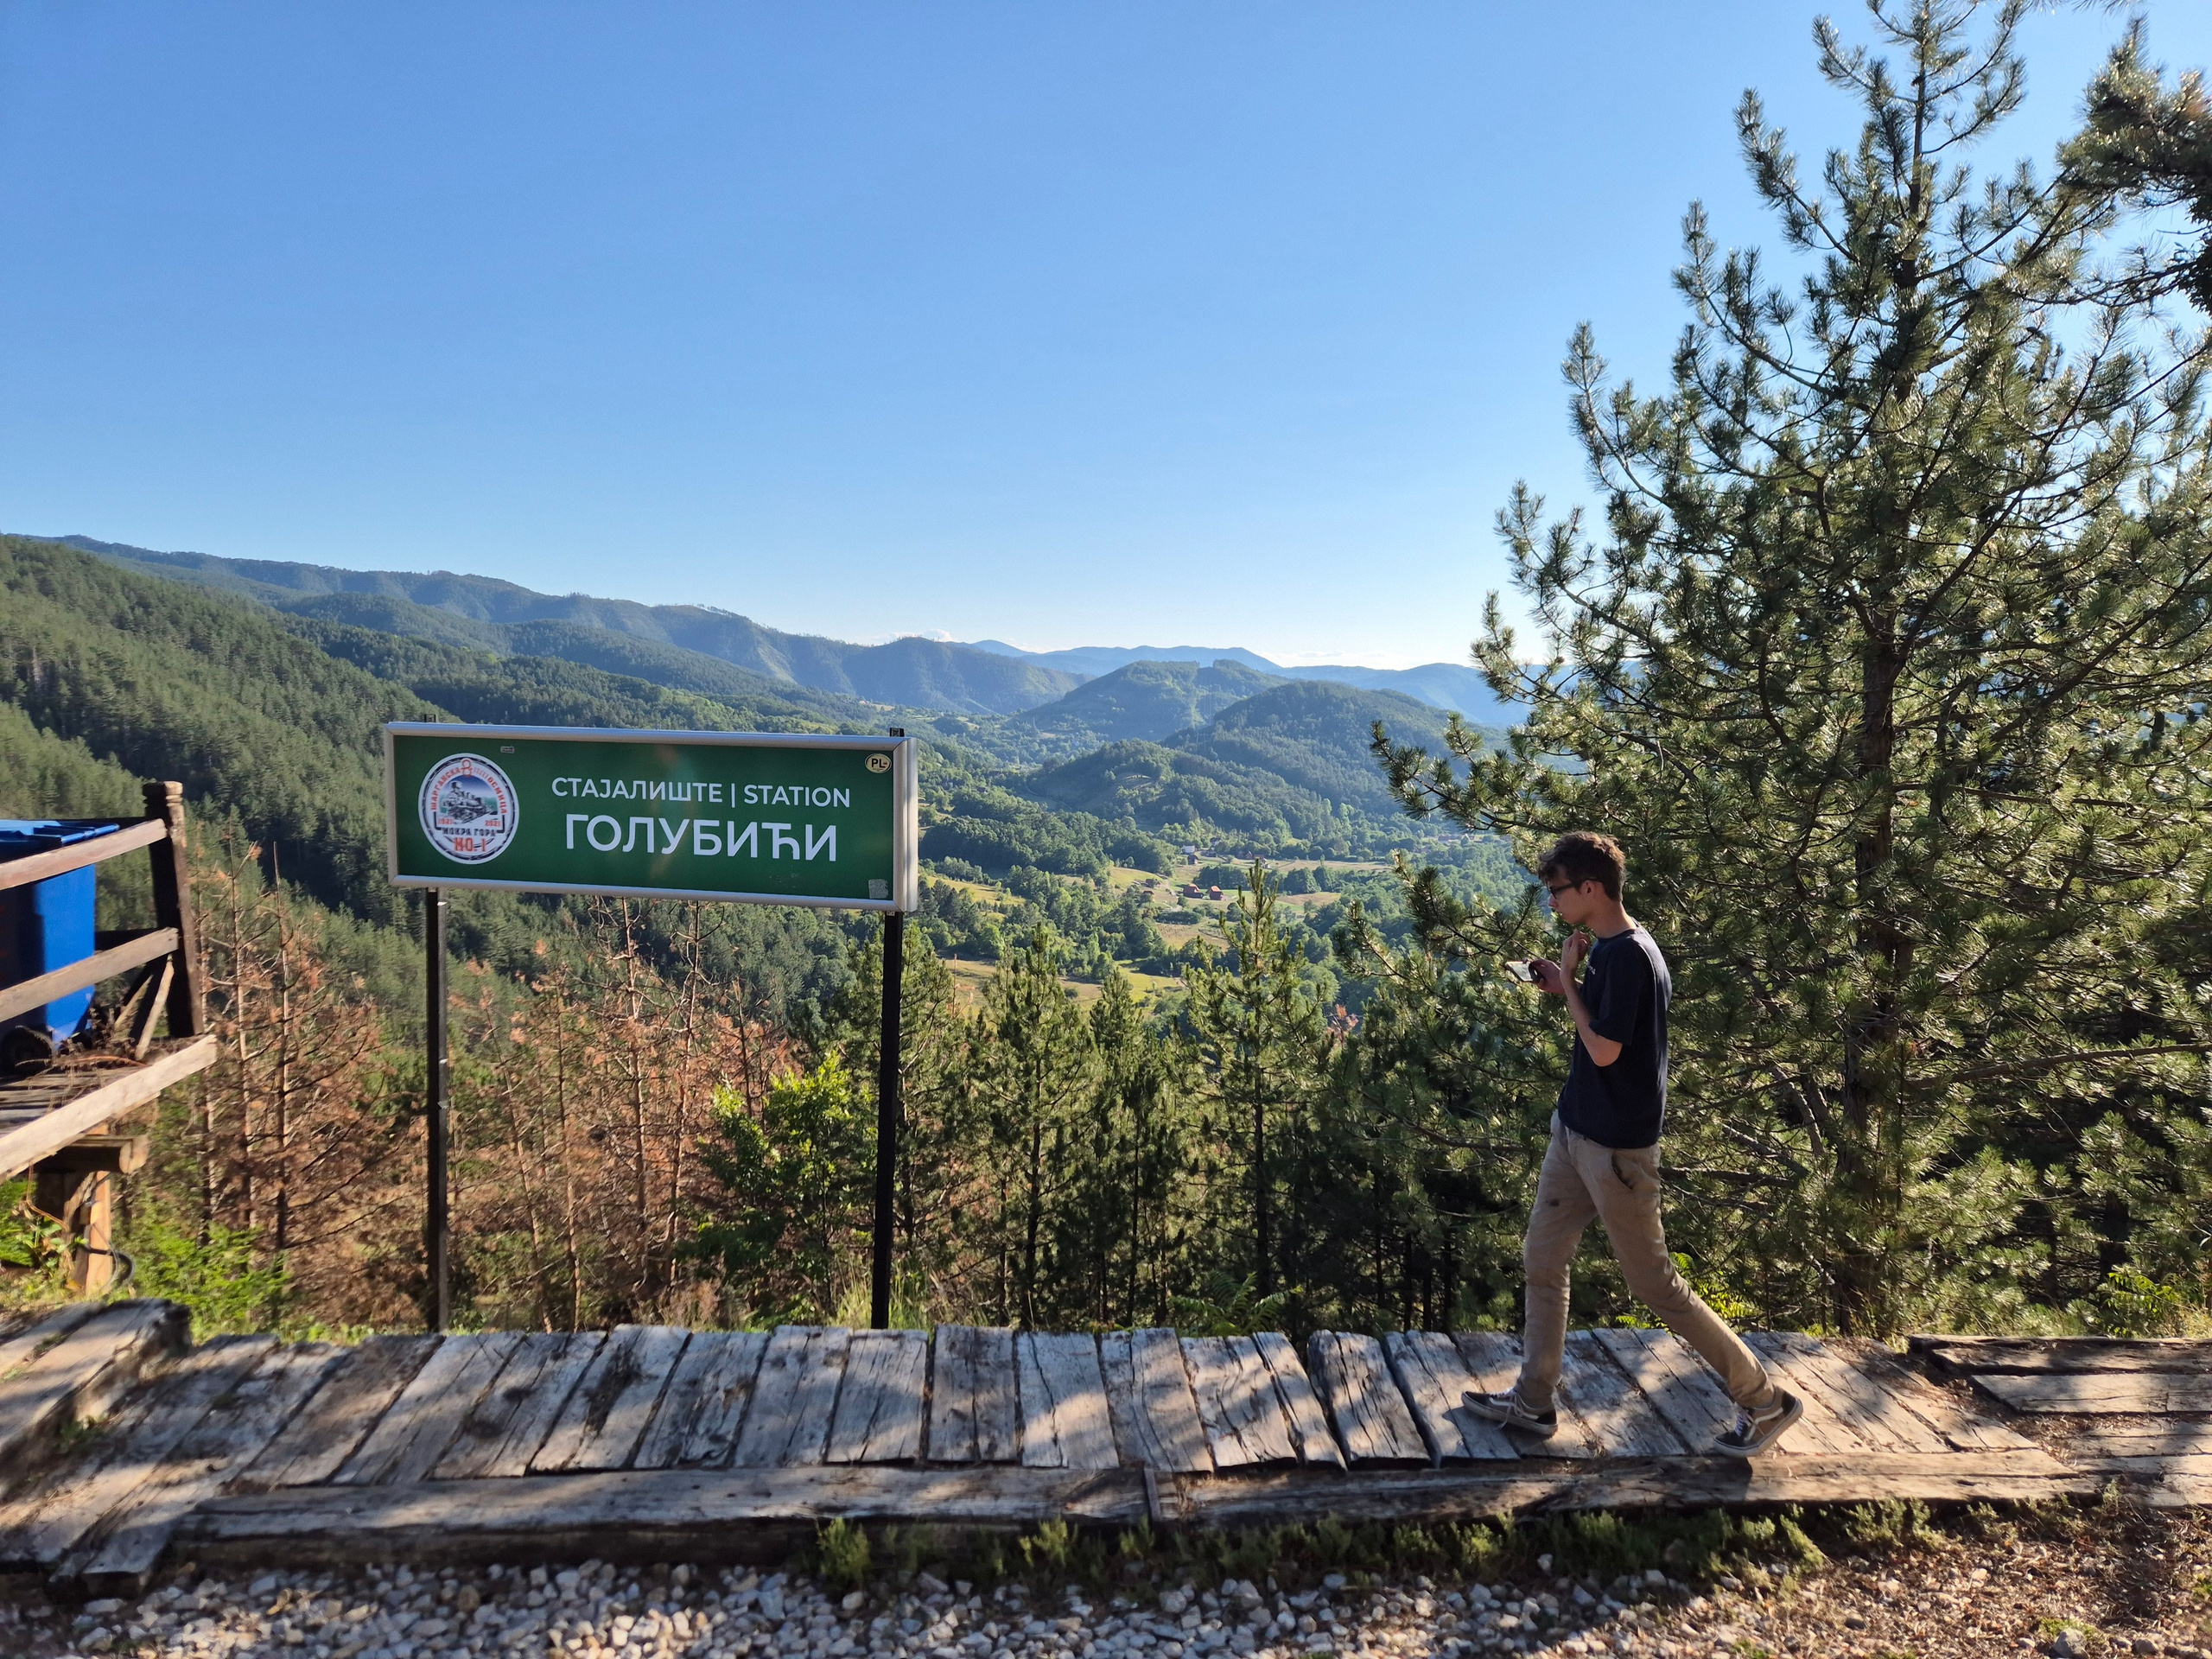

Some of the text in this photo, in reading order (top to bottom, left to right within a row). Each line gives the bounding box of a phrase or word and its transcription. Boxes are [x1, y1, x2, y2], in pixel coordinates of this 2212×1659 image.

[871, 758, 886, 768] PL
[551, 777, 850, 808] СТАЈАЛИШТЕ STATION
[442, 827, 496, 836] МОКРА ГОРА
[566, 813, 836, 862] ГОЛУБИЋИ
